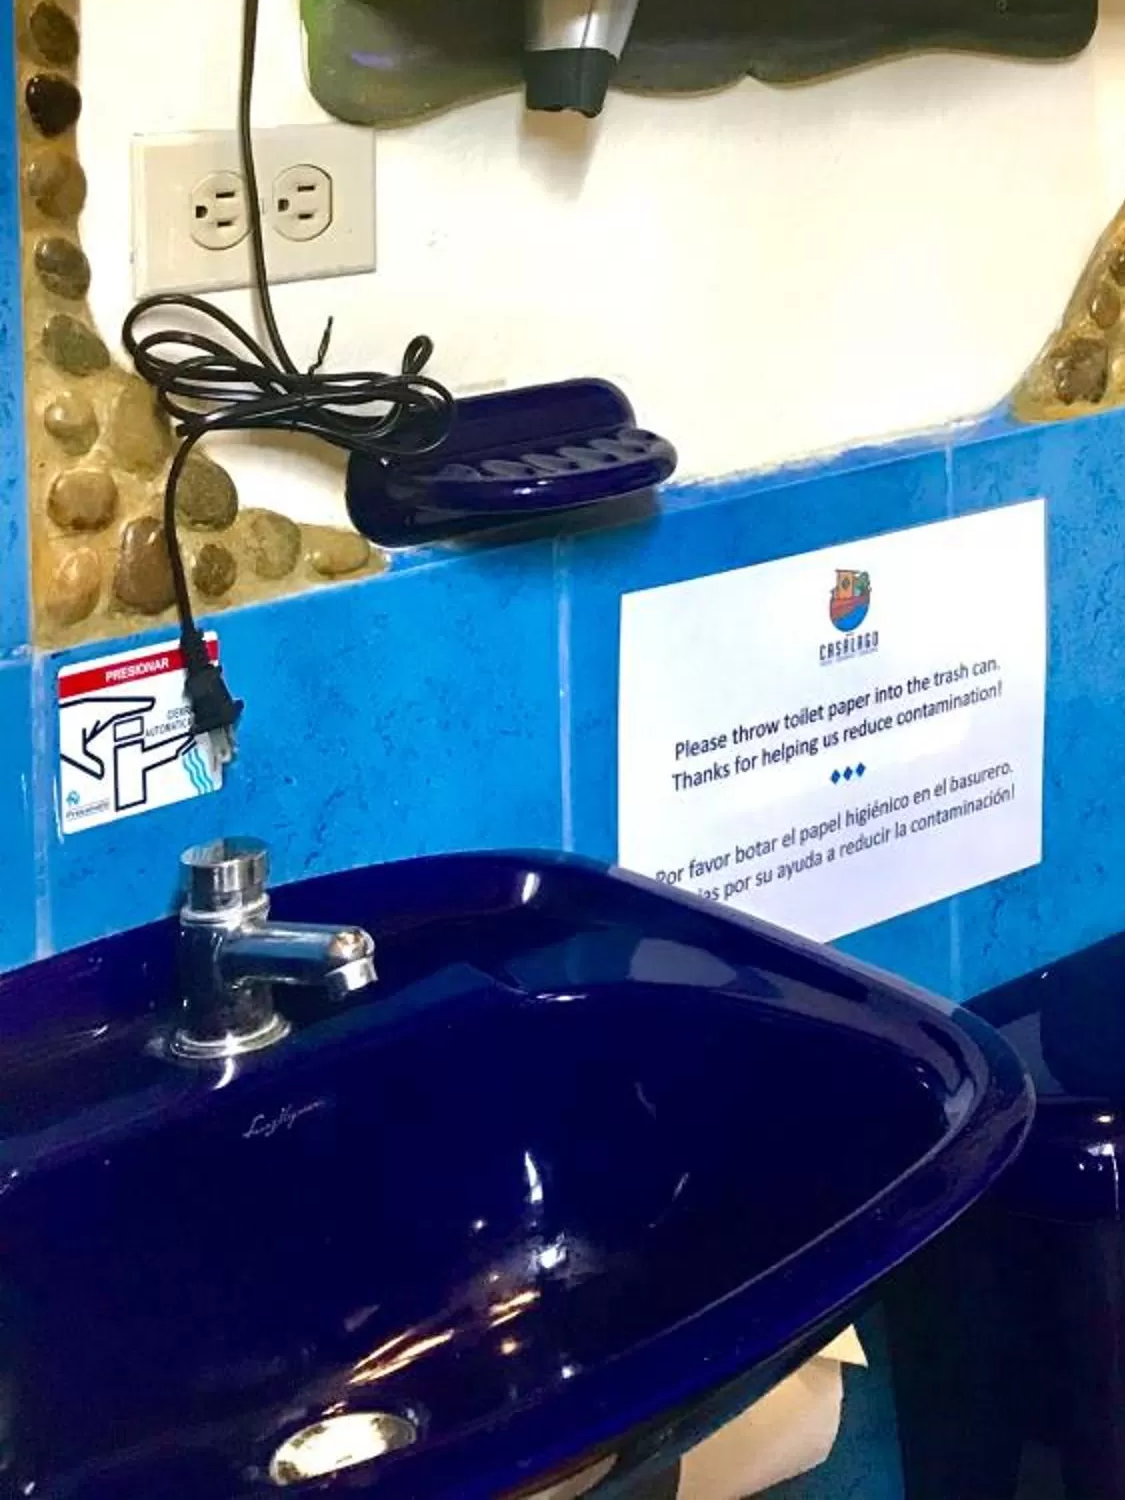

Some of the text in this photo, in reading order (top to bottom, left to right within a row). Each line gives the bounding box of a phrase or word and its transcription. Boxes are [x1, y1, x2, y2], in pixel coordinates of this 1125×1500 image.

[105, 657, 170, 682] PRESIONAR
[675, 659, 1000, 761] Please throw toilet paper into the trash can.
[672, 762, 731, 792] Thanks
[734, 755, 758, 774] for
[762, 737, 819, 767] helping
[823, 731, 839, 748] us
[843, 715, 893, 742] reduce
[656, 868, 684, 886] Por
[688, 853, 731, 879] favor
[735, 838, 778, 864] botar
[782, 827, 796, 848] el
[800, 814, 841, 846] papel
[913, 788, 930, 805] en
[934, 778, 947, 797] el
[949, 762, 1013, 793] basurero.
[724, 876, 752, 901] por
[756, 869, 773, 886] su
[777, 850, 823, 880] ayuda
[827, 847, 835, 862] a
[839, 827, 891, 857] reducir
[894, 822, 907, 839] la
